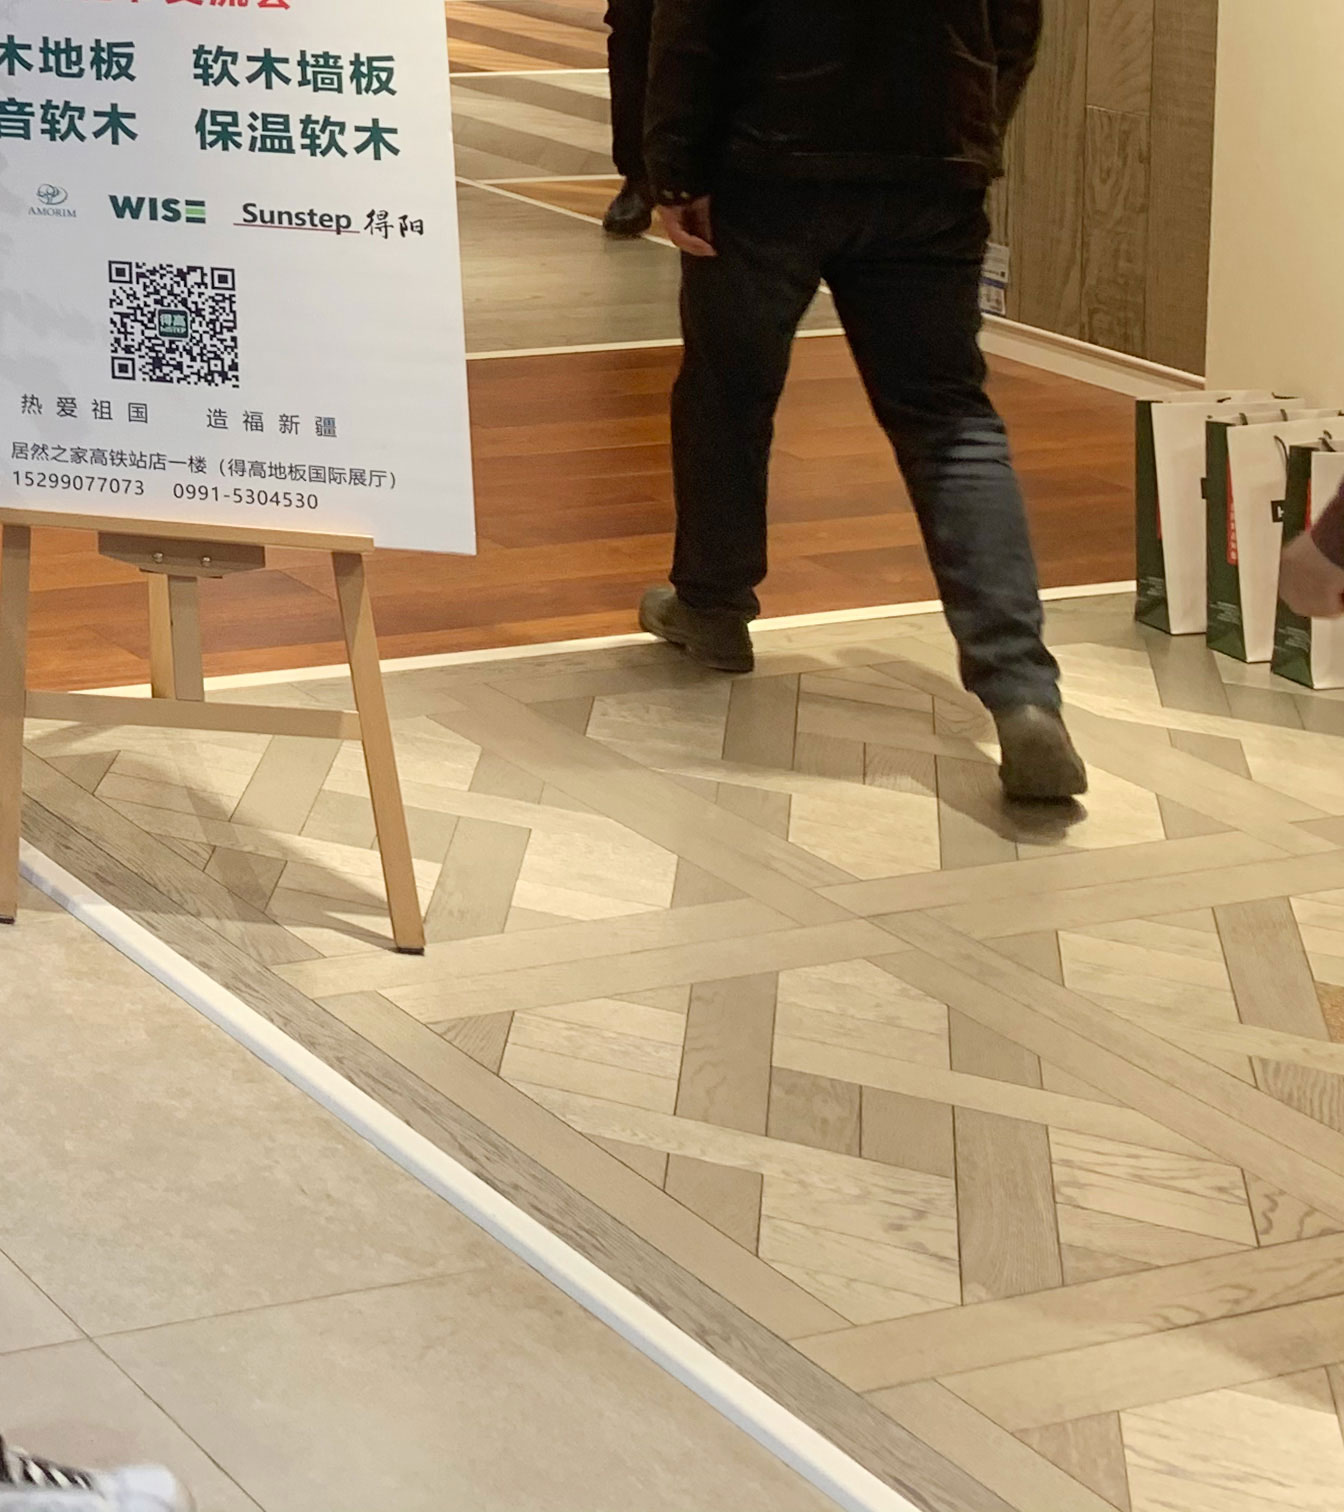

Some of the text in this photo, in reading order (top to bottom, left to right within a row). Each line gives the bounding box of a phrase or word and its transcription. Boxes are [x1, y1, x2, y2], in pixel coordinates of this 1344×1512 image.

[192, 43, 398, 97] 软木墙板
[195, 107, 401, 161] 保温软木
[28, 206, 78, 218] AMORIM
[242, 202, 352, 235] Sunstep
[19, 393, 338, 439] 热爱祖国 造福新疆
[172, 481, 320, 511] 0991-5304530
